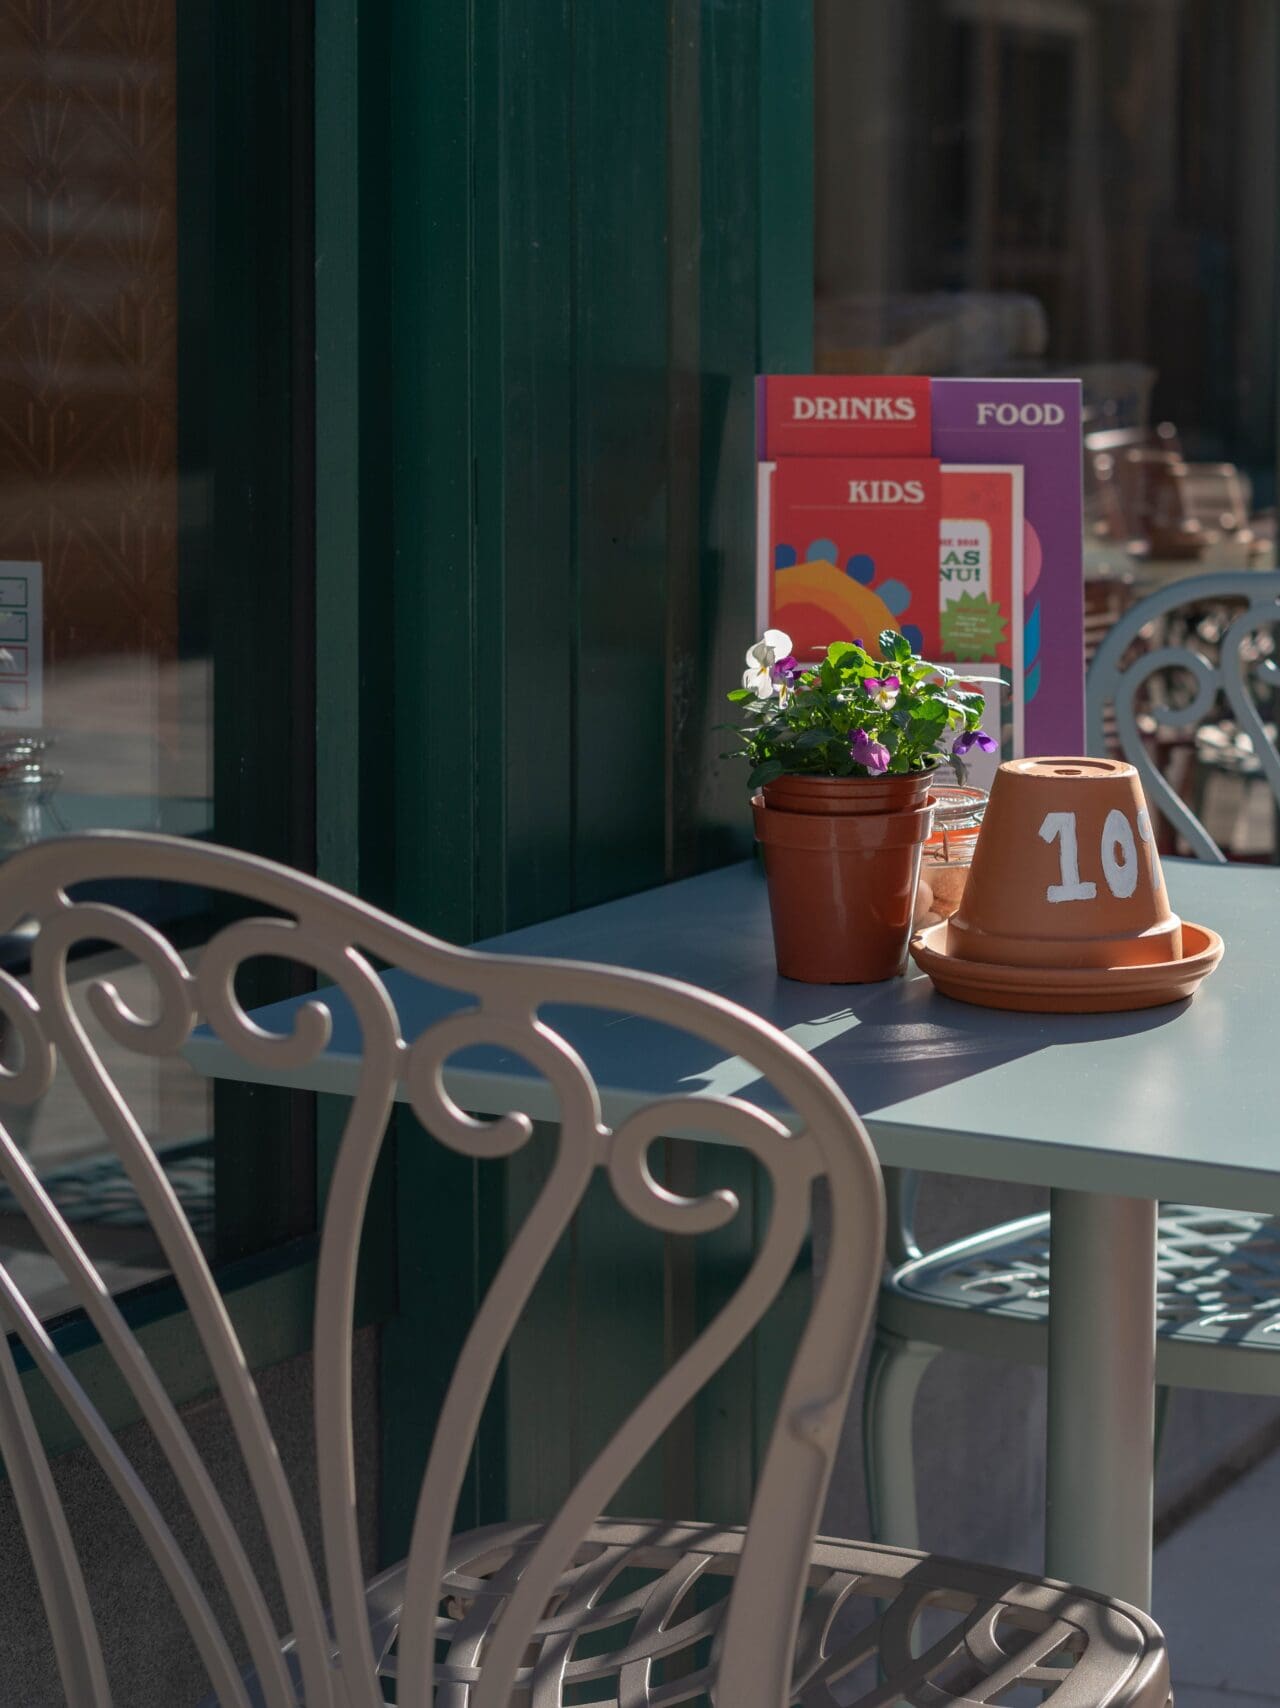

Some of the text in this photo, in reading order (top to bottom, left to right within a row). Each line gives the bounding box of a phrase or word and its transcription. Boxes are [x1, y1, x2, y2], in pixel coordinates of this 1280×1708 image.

[792, 396, 917, 421] DRINKS
[976, 402, 1065, 426] FOOD
[848, 480, 925, 504] KIDS
